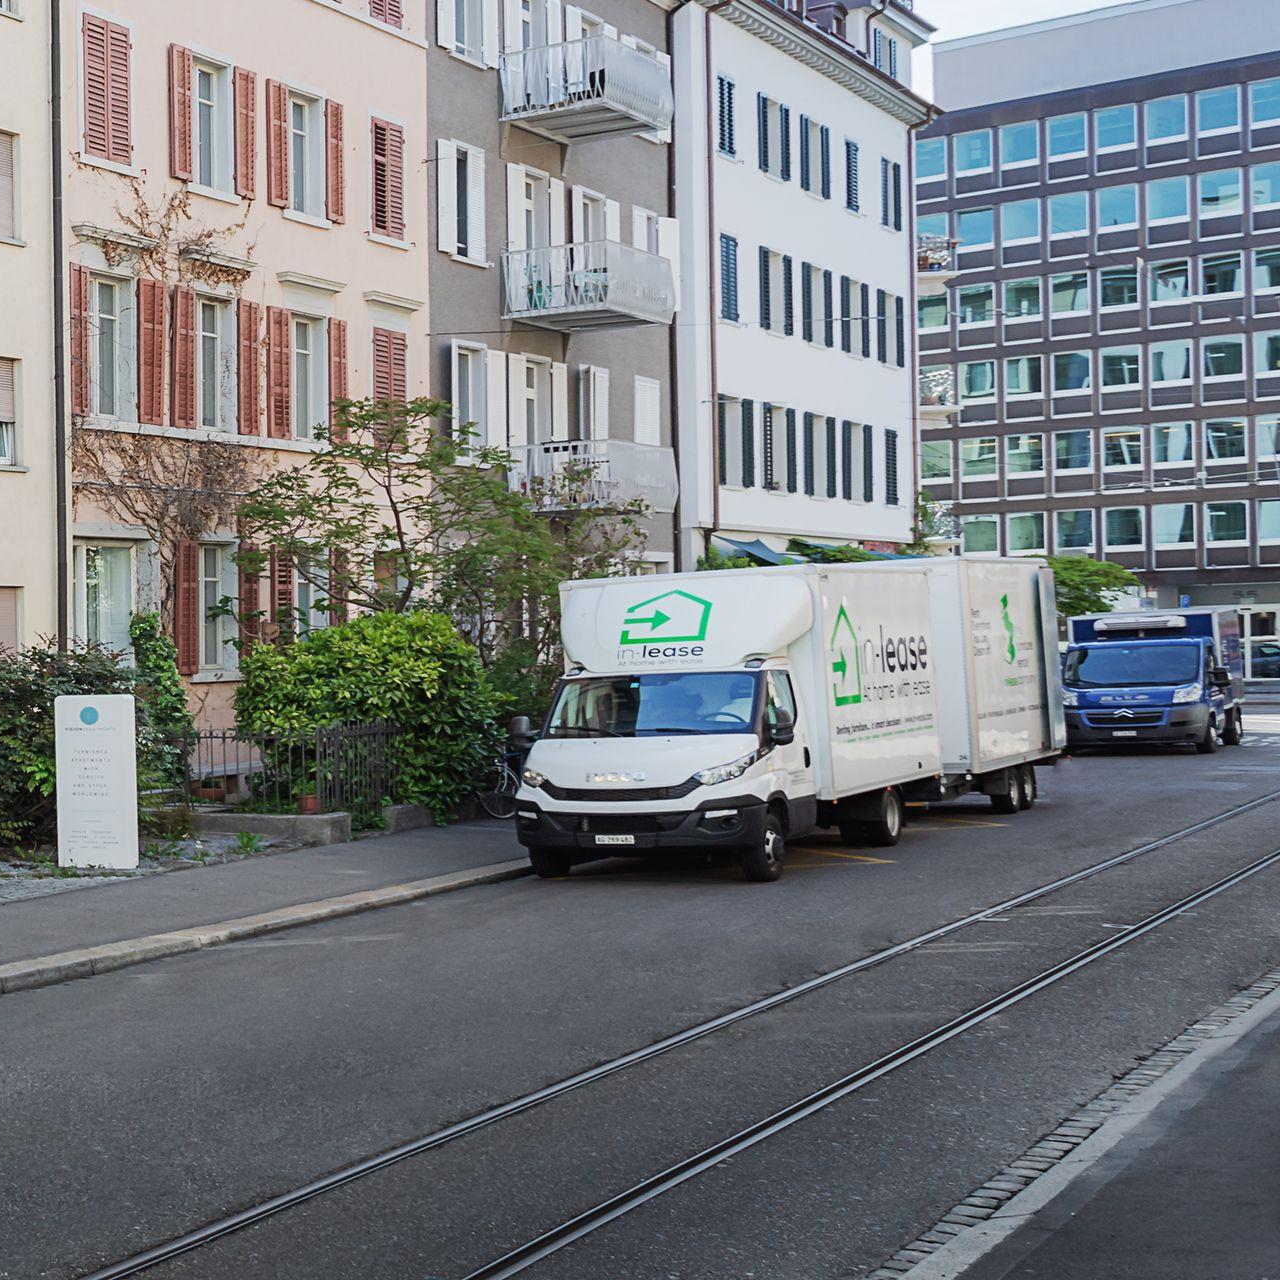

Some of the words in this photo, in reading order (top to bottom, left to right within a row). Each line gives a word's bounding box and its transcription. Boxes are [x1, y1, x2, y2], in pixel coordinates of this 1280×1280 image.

[617, 645, 704, 660] in-lease
[858, 624, 928, 677] in-lease
[585, 770, 646, 783] IVECO
